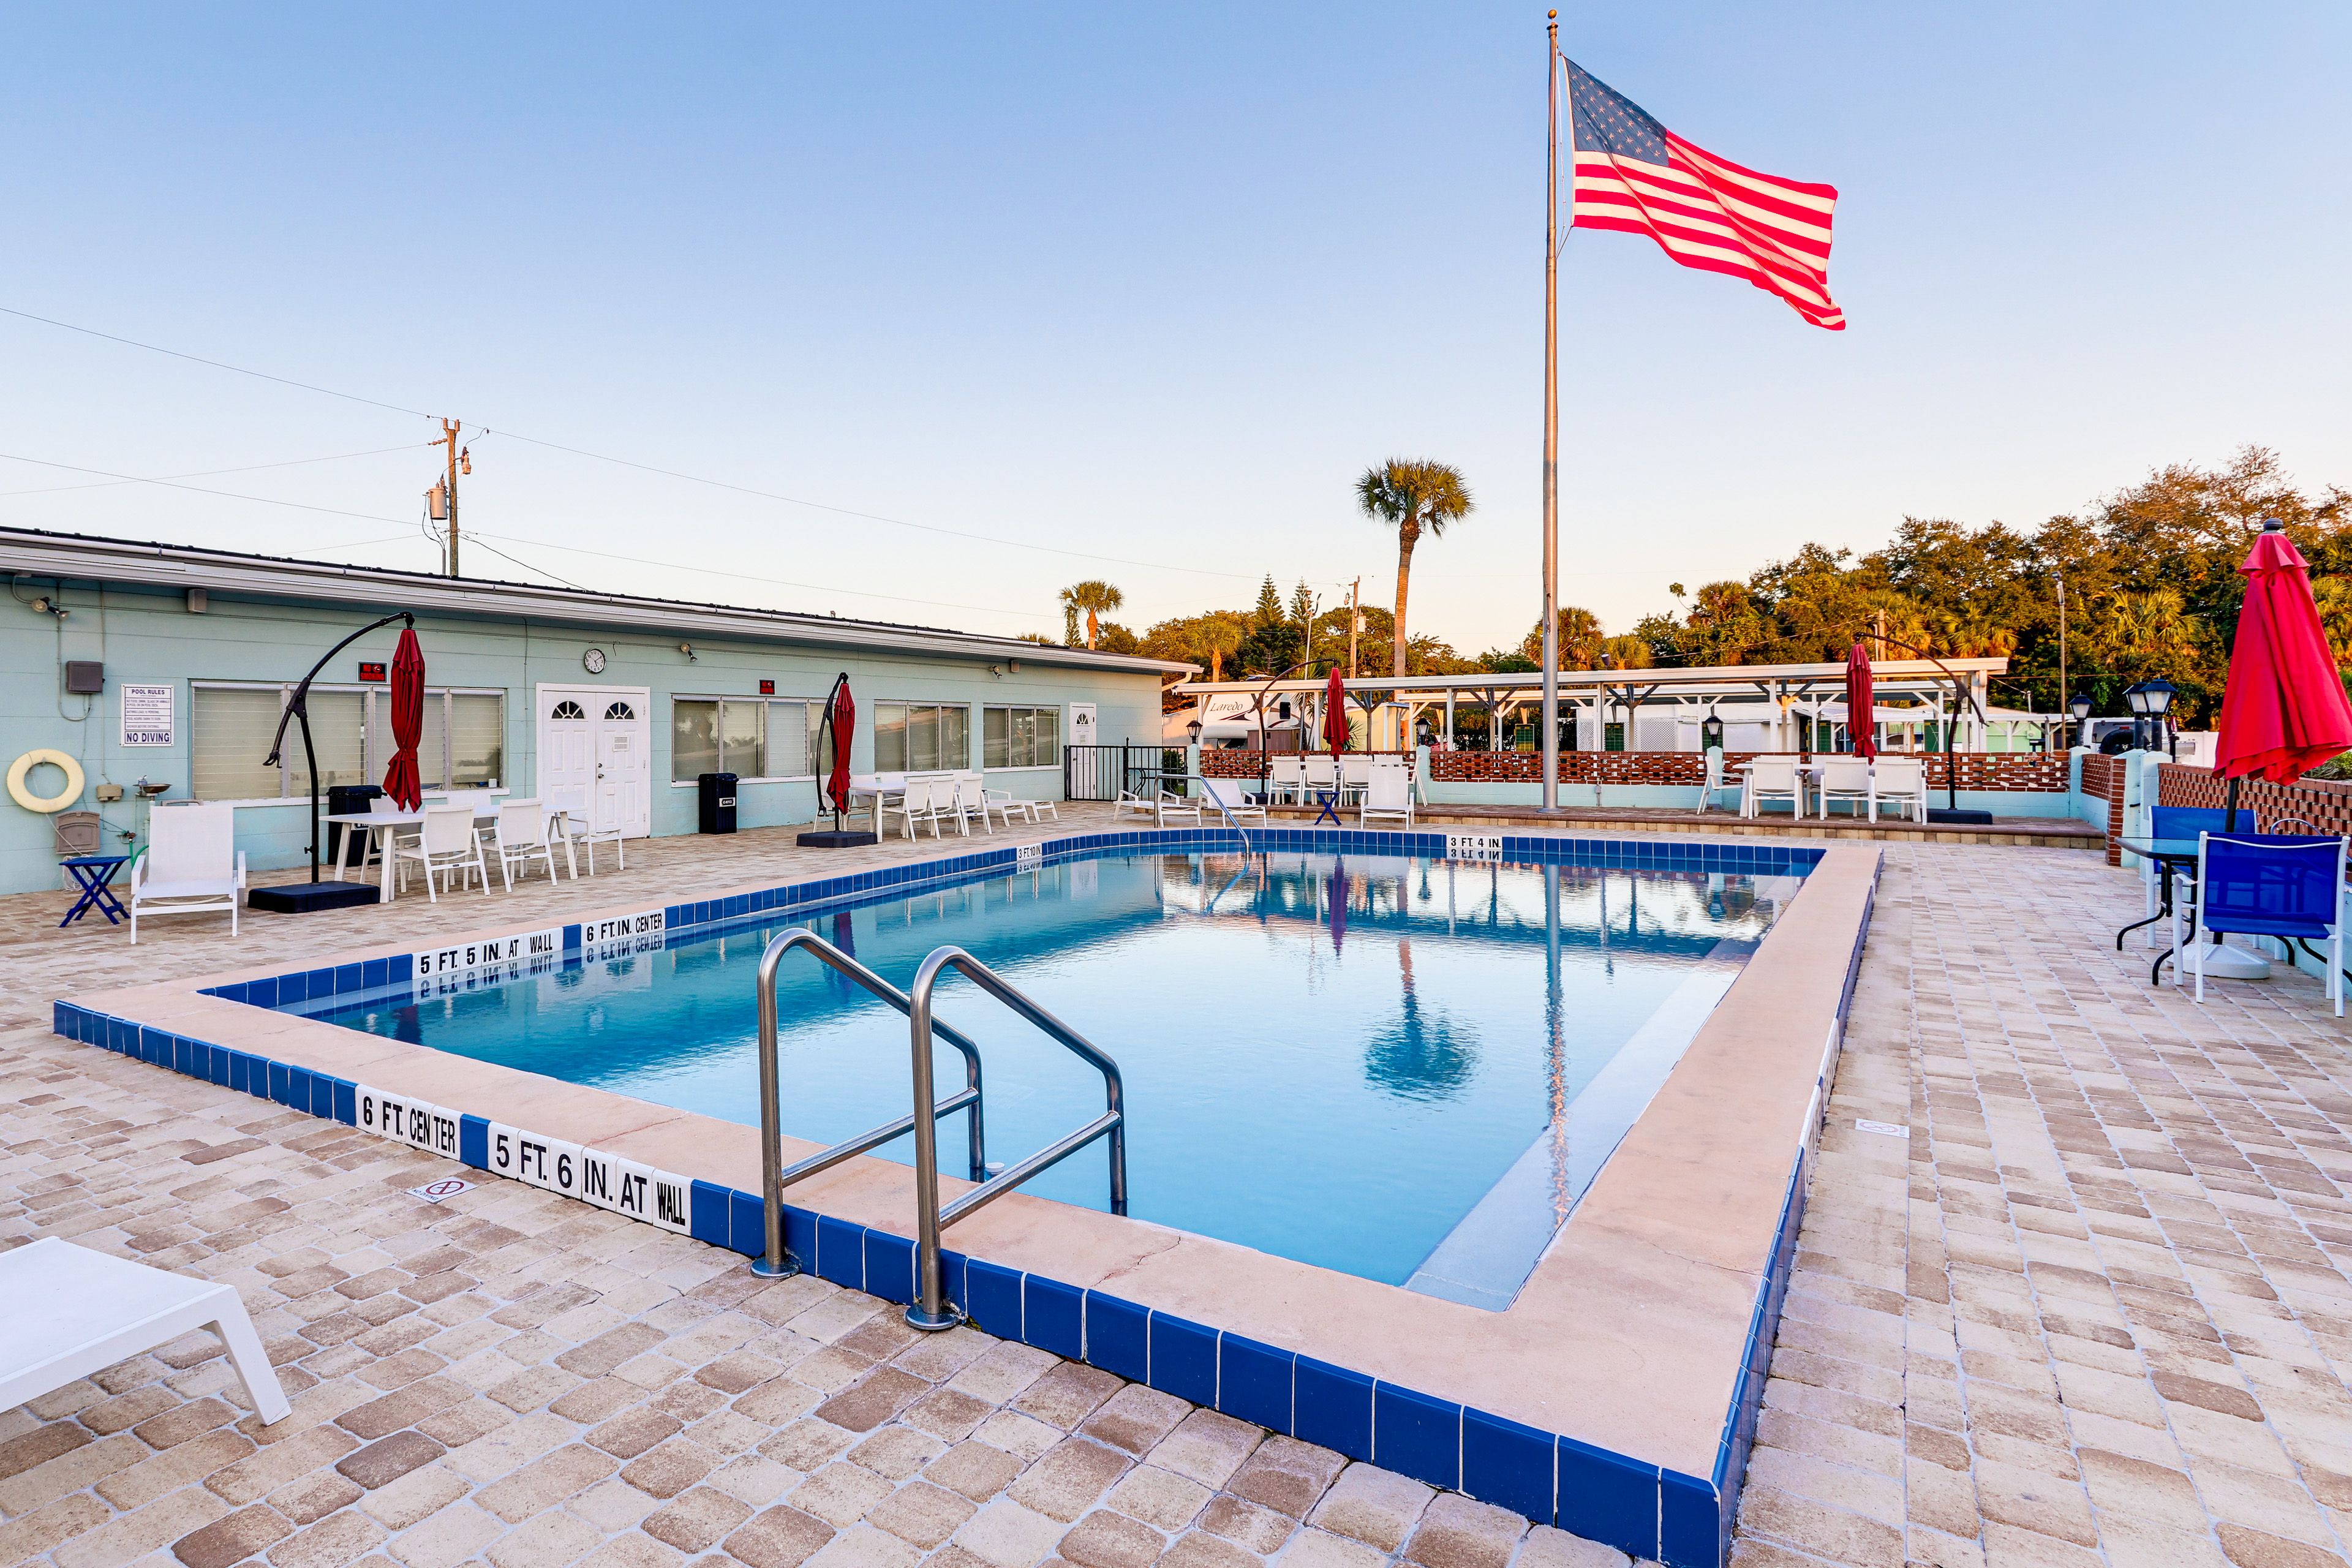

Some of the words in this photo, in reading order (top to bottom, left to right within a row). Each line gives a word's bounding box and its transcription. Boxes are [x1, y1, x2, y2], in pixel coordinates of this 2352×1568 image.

[1209, 701, 1243, 712] Laredo
[127, 733, 138, 742] NO
[141, 733, 170, 742] DIVING
[1451, 837, 1457, 846] 3
[1461, 838, 1473, 846] FT.
[1478, 838, 1483, 847] 4
[1489, 839, 1501, 848] IN.
[1019, 849, 1022, 858] 3
[587, 926, 594, 942] 6
[636, 913, 663, 933] CENTER
[420, 956, 429, 974] 5
[439, 950, 458, 971] FT.
[467, 947, 476, 965] 5
[483, 943, 502, 962] IN.
[508, 940, 519, 958] AT
[530, 933, 552, 954] WALL
[363, 1096, 372, 1126] 6
[382, 1101, 403, 1136] FT.
[410, 1107, 456, 1154] CENTER
[496, 1134, 510, 1167] 5
[521, 1140, 547, 1181] FT.
[557, 1153, 573, 1189] 6
[584, 1158, 612, 1202] IN.
[620, 1172, 647, 1213] AT
[657, 1182, 685, 1226] WALL
[420, 1192, 439, 1200] DIVING
